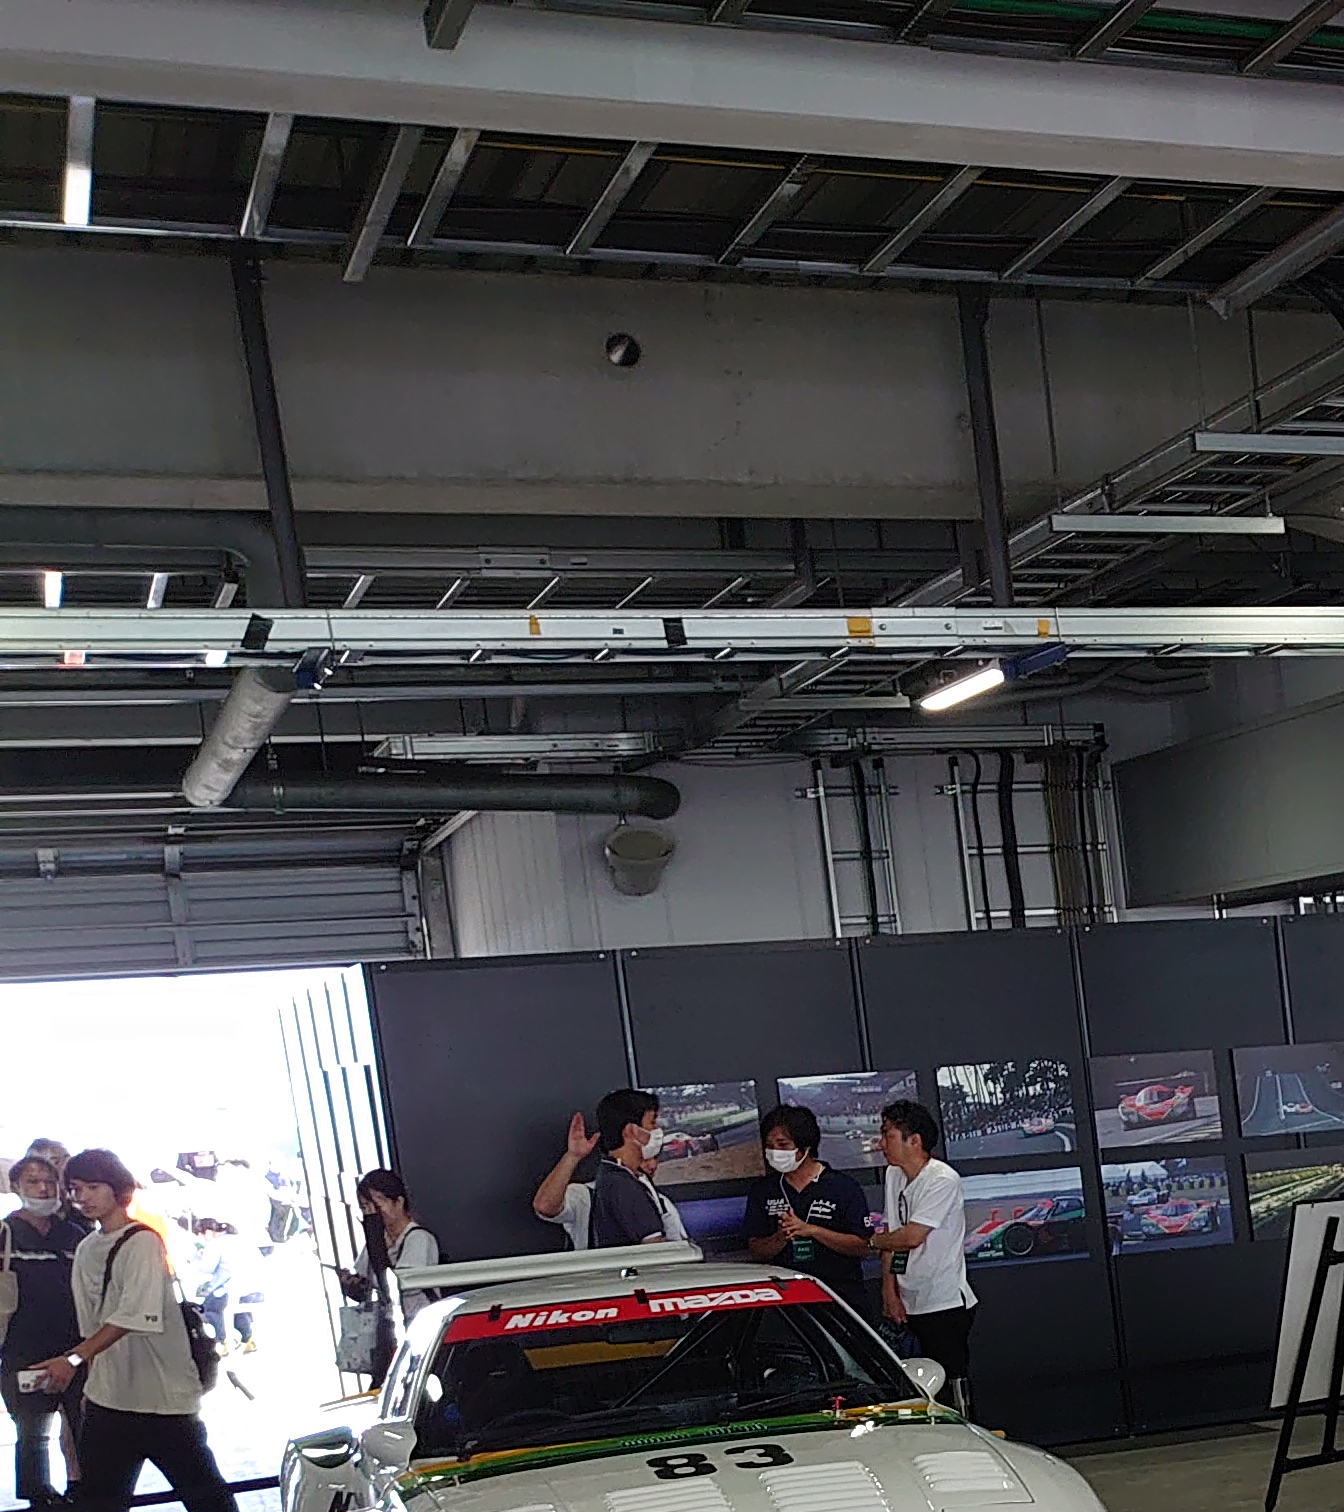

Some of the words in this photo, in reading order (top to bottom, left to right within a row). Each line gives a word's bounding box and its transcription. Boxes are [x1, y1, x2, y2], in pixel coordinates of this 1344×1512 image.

[648, 1287, 783, 1314] mazda
[503, 1305, 619, 1331] Nikon
[646, 1443, 796, 1481] 83
